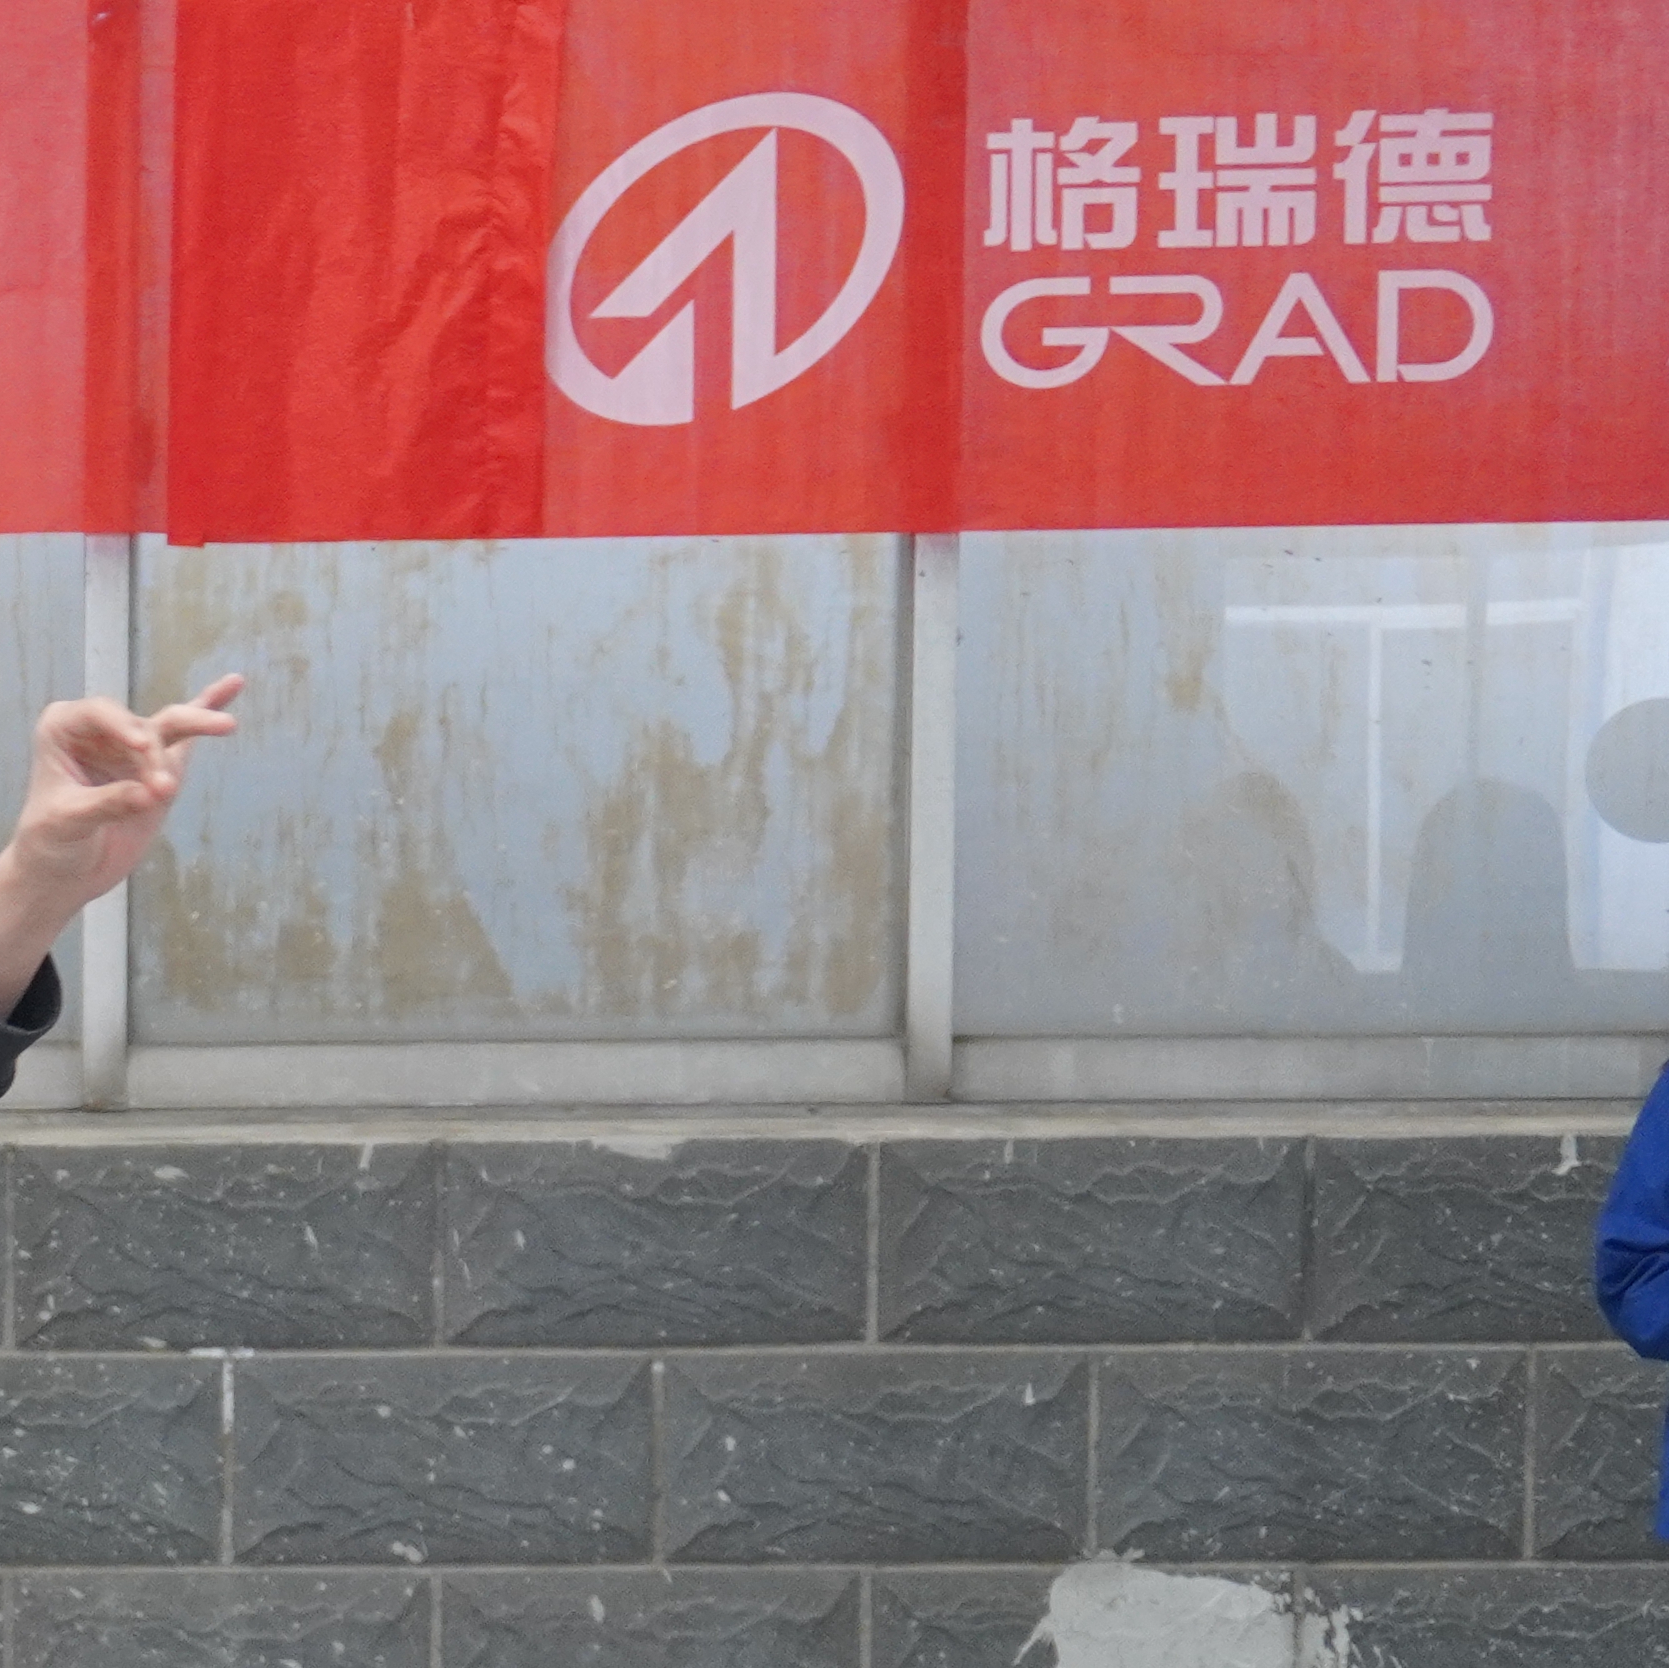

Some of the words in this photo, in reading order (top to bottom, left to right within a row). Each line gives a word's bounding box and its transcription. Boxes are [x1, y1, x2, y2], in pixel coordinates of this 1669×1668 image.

[983, 108, 1492, 251] 格瑞德
[979, 269, 1494, 389] GRAD
